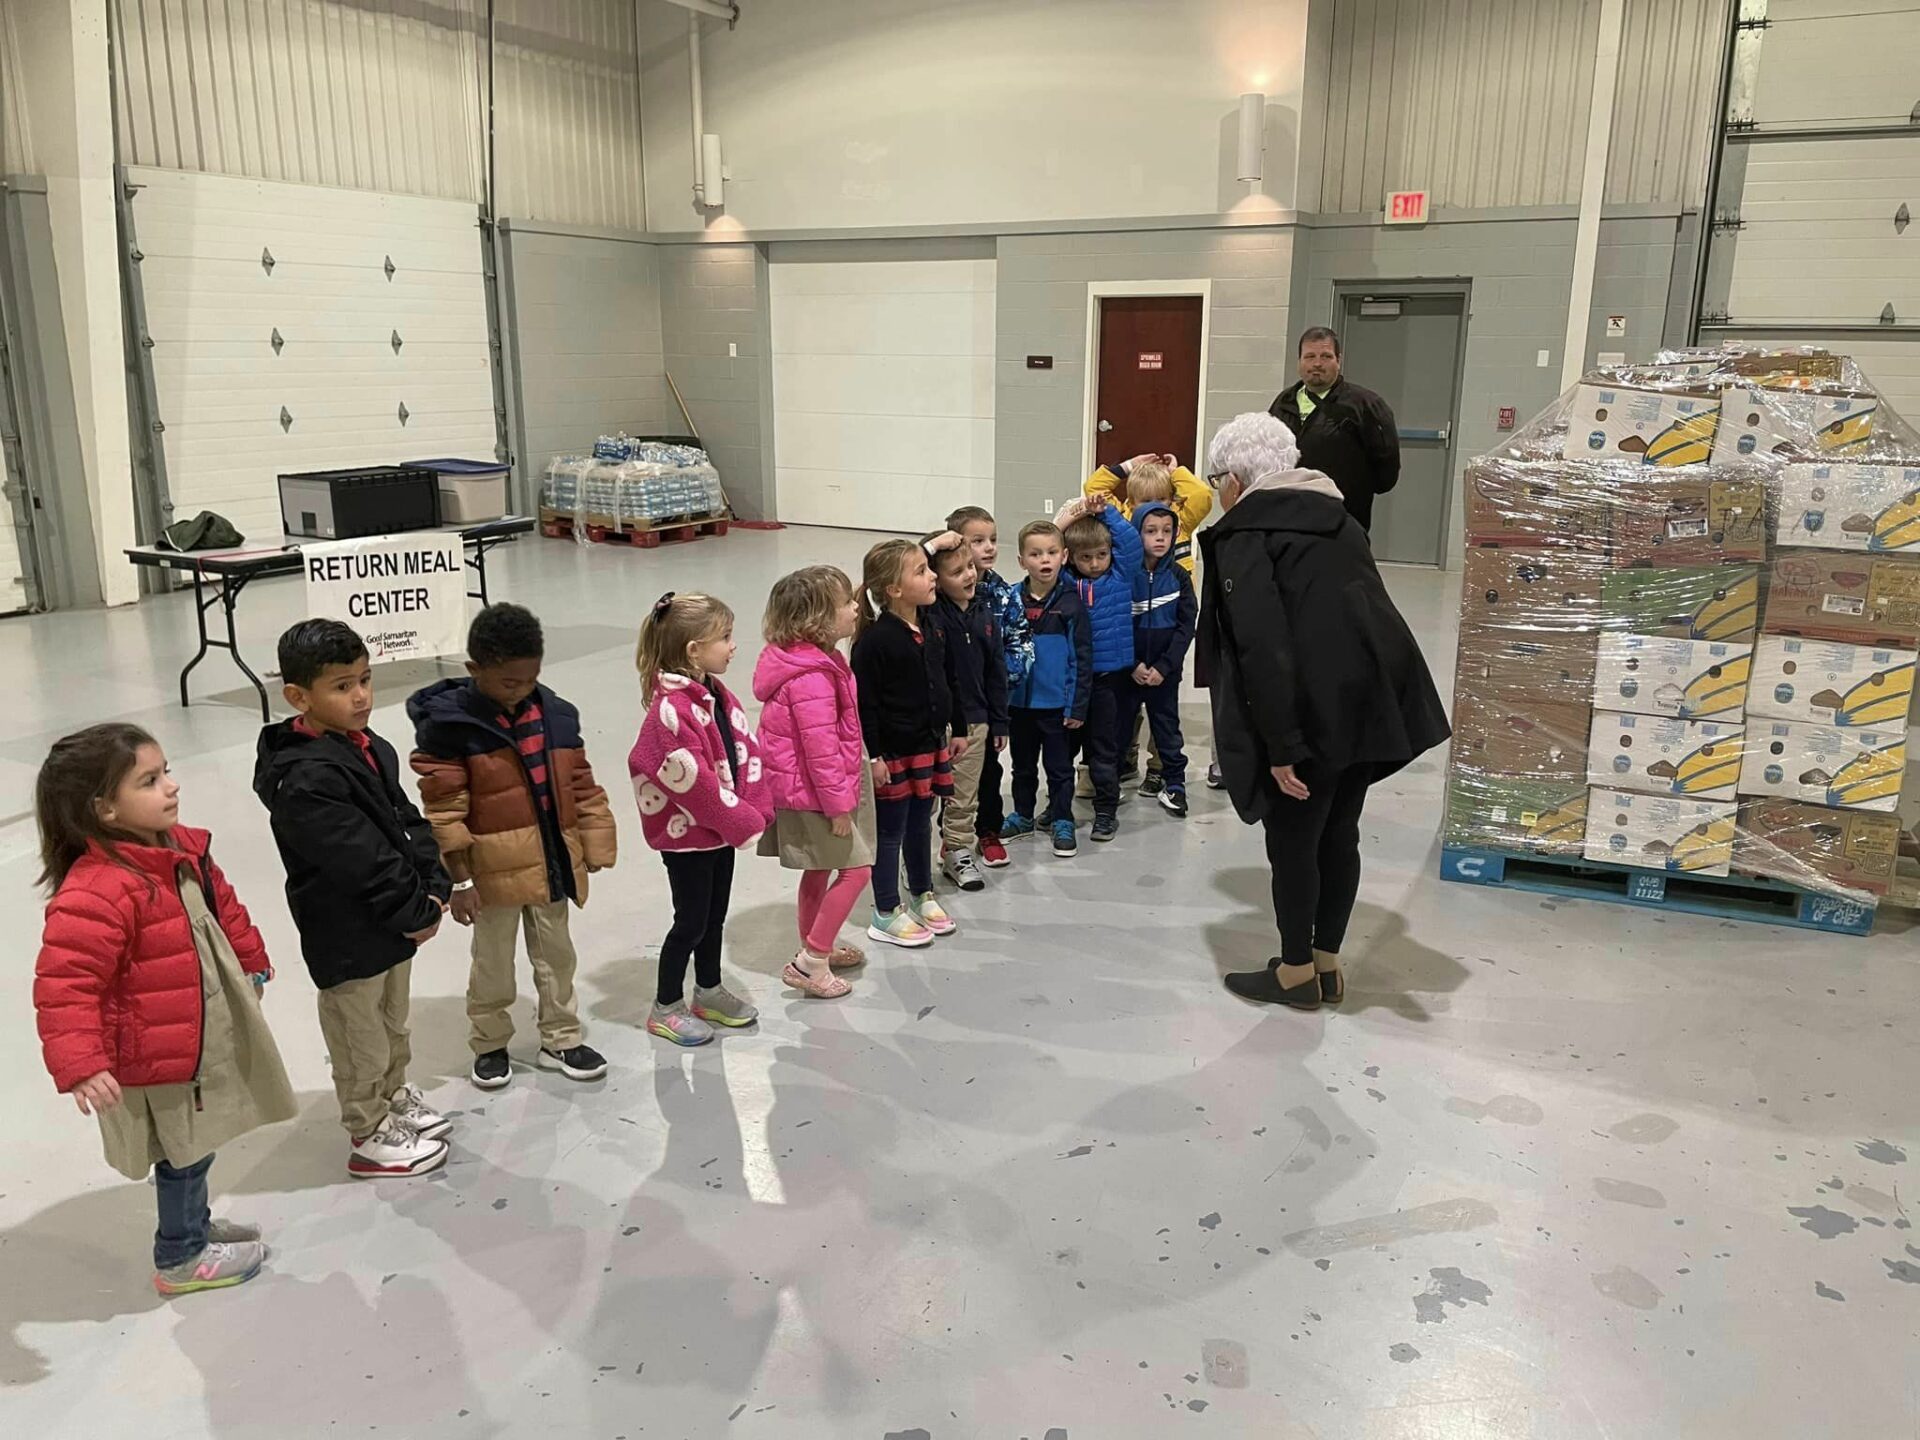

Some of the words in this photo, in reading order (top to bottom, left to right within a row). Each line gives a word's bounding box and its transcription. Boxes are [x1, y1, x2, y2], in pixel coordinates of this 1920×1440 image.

[1392, 194, 1424, 217] EXIT
[309, 552, 398, 582] RETURN
[404, 550, 460, 575] MEAL
[348, 588, 430, 617] CENTER
[366, 633, 383, 644] Good
[383, 630, 418, 640] Samaritan
[1812, 909, 1827, 922] OF
